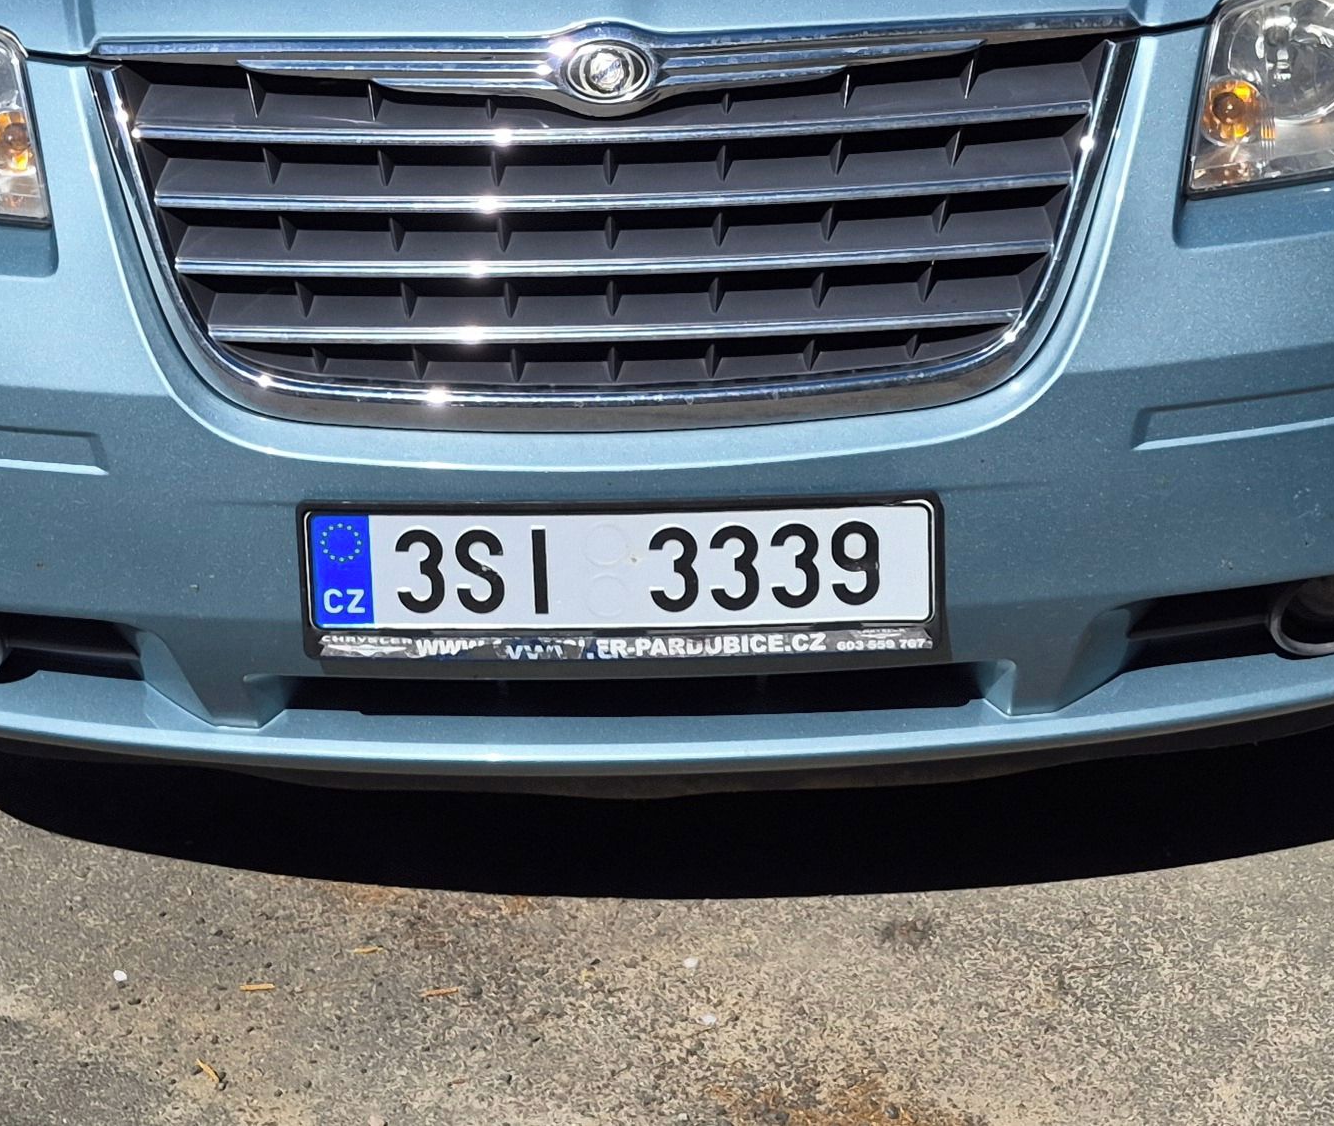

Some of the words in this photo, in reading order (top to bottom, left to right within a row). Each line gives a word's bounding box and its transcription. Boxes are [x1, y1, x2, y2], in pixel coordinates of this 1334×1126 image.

[395, 528, 549, 614] 3SI
[648, 520, 880, 613] 3339
[323, 588, 366, 614] CZ
